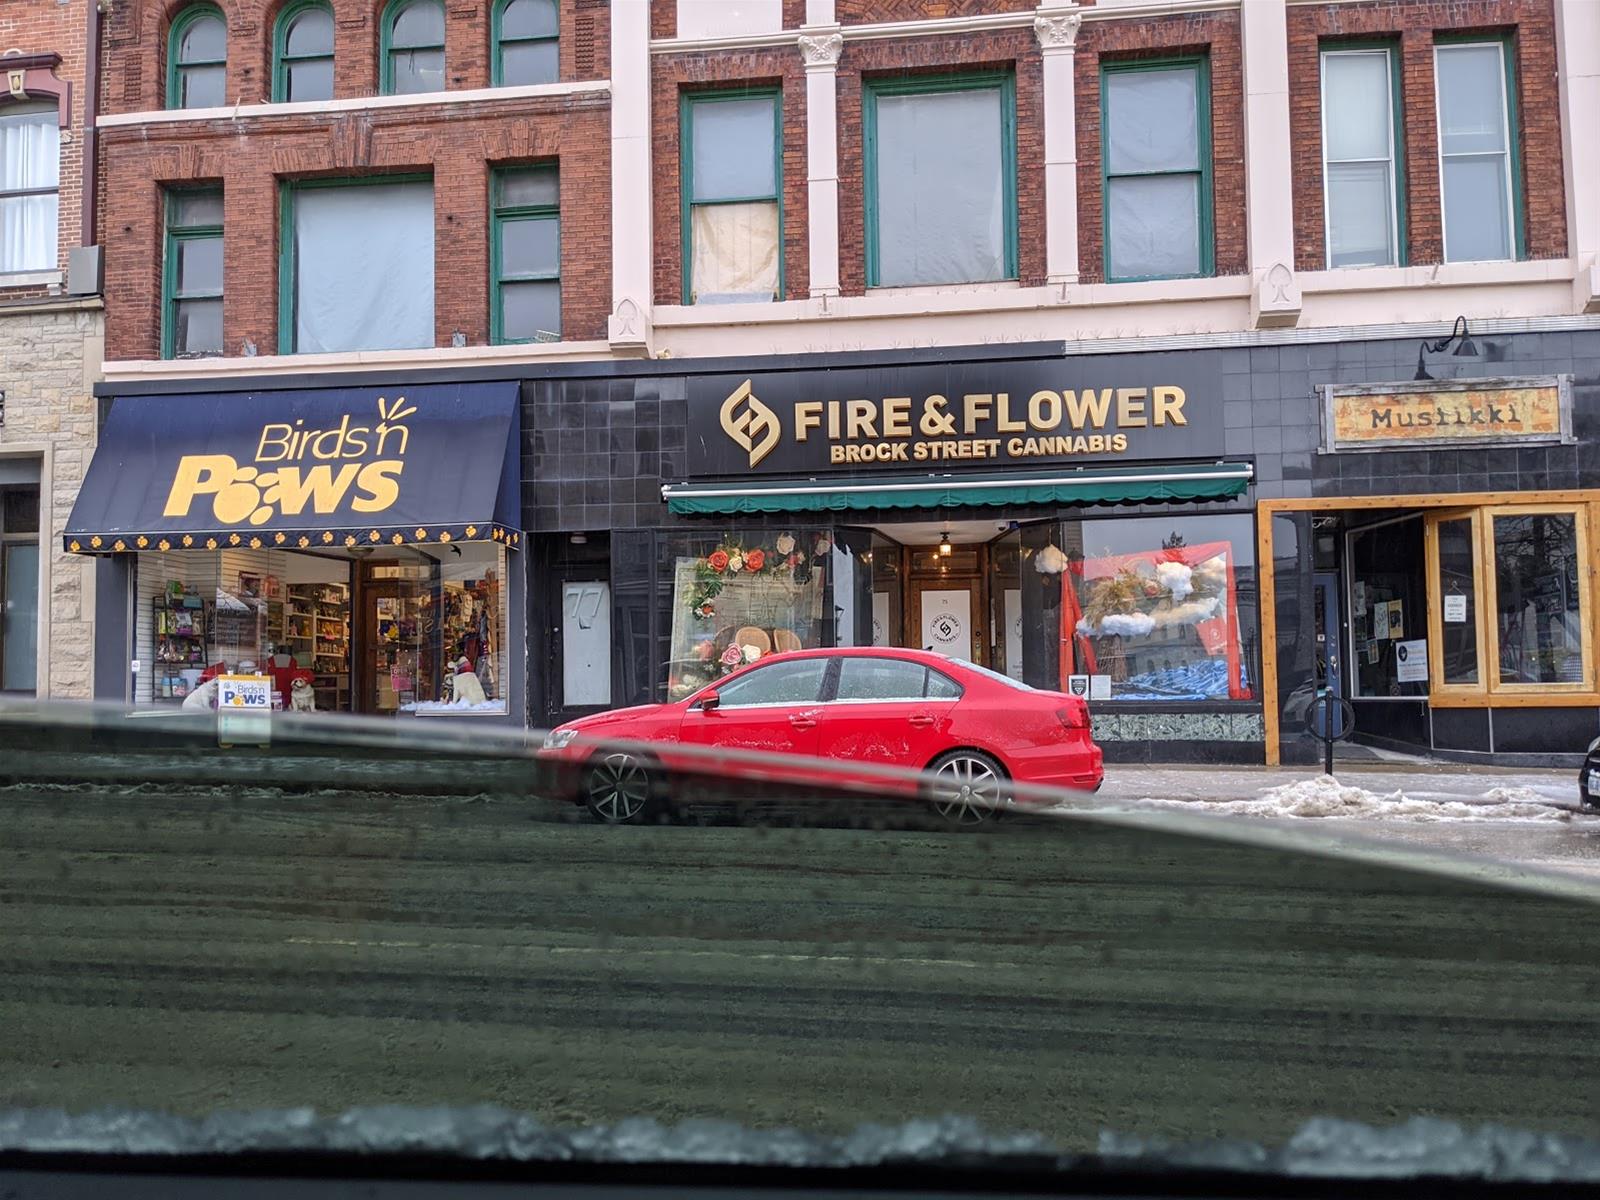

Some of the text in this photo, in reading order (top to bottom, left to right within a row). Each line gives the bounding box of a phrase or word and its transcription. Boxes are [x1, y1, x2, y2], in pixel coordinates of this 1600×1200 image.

[794, 398, 913, 441] FIRE
[963, 385, 1188, 435] FLOWER
[255, 414, 369, 462] Birds
[830, 433, 1128, 464] BROCK STREET CANNABIS
[566, 587, 604, 618] 77
